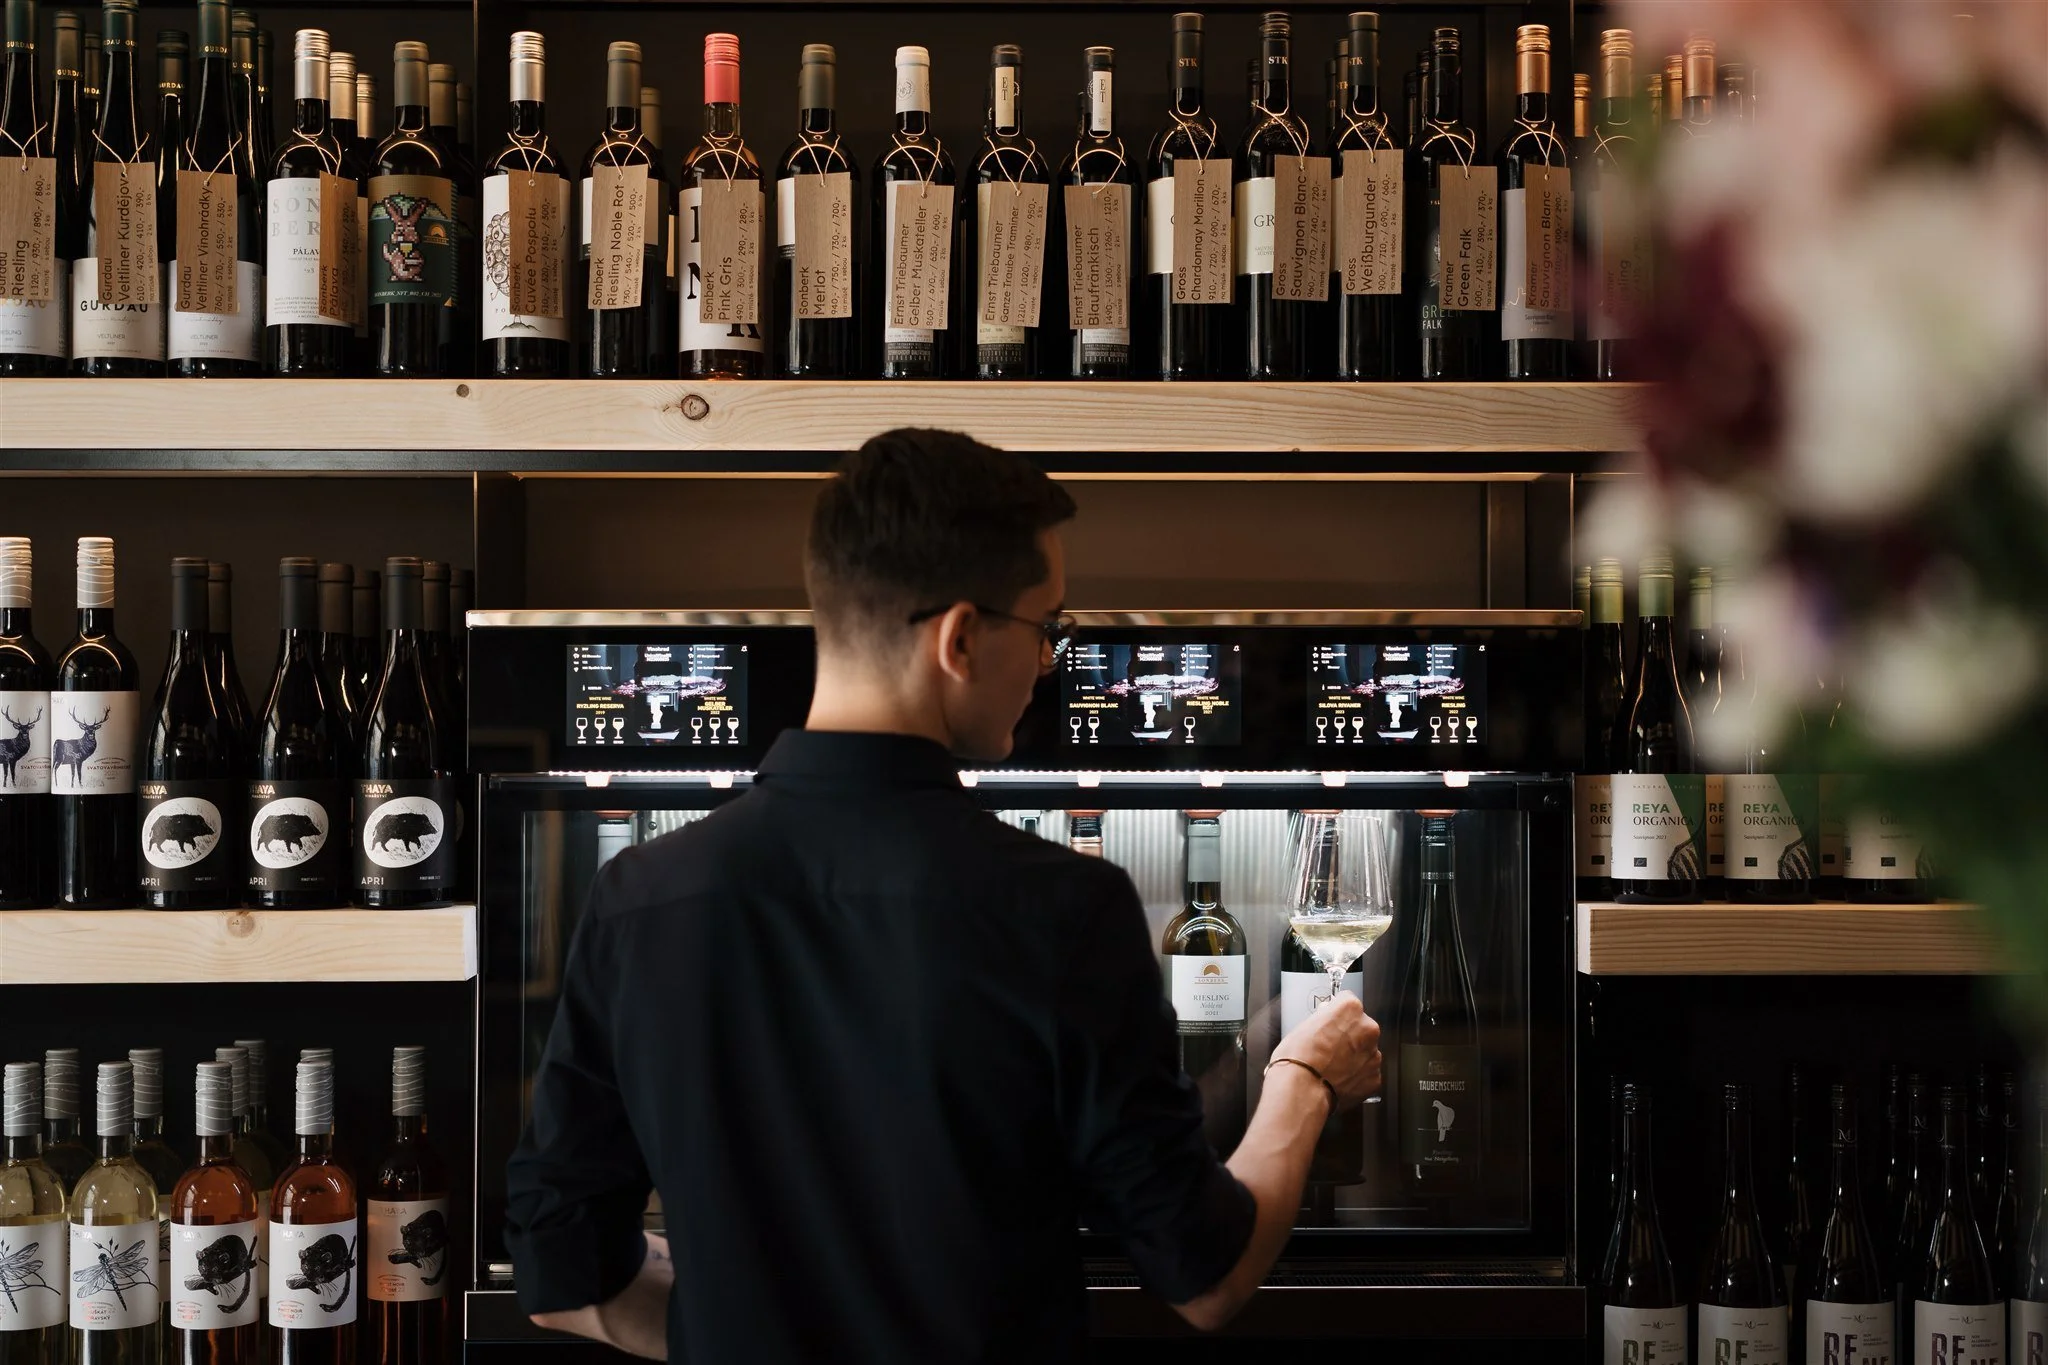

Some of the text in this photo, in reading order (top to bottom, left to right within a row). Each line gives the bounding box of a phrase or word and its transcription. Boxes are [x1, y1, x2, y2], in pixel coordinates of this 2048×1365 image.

[1178, 58, 1198, 68] STK
[1268, 56, 1288, 65] STK
[116, 177, 131, 301] Veltliner Kurdějov
[196, 187, 211, 310] Veltliner Vinohrádky
[293, 247, 320, 255] PÁLAV
[607, 185, 624, 305] Riesling Noble Rot
[1191, 179, 1206, 300] Chardonnay Morillon
[1291, 176, 1307, 297] Sauvignon Blanc
[1361, 178, 1377, 291] Weißburgunder
[1540, 191, 1553, 308] Sauvignon Blanc
[12, 241, 28, 295] Riesling
[102, 258, 113, 300] Gurdau
[524, 207, 538, 313] Cuvée Pospolu
[592, 258, 604, 305] Sonberk
[894, 224, 909, 325] Ernst Triebaumer
[909, 206, 927, 326] Gelber Muskateller
[985, 221, 1003, 321] Ernst Triebaumer
[1000, 206, 1019, 322] Ganze Traube Traminer
[1073, 225, 1083, 325] Ernst Triebaumer
[1087, 228, 1100, 325] Blaufränkisch
[1176, 267, 1187, 299] Gross
[1277, 263, 1286, 295] Gross
[1346, 258, 1356, 290] Gross
[1443, 261, 1454, 306] Kramer
[1458, 229, 1471, 306] Green Falk
[1528, 261, 1538, 306] Kramer
[180, 266, 191, 309] Gurdau
[319, 265, 328, 313] Sonberk
[329, 268, 340, 316] Pálava
[511, 263, 521, 311] Sonberk
[704, 272, 714, 320] Sonberk
[719, 257, 731, 320] Pink Gris
[799, 267, 809, 315] Sonberk
[814, 270, 825, 315] Merlot
[1422, 320, 1442, 331] FALK
[1632, 803, 1670, 814] REYA
[1743, 803, 1780, 814] REYA
[141, 878, 160, 887] APRI
[249, 877, 267, 886] APRI
[361, 877, 384, 886] APRI
[1419, 1080, 1465, 1091] TAUBENSCHUSS
